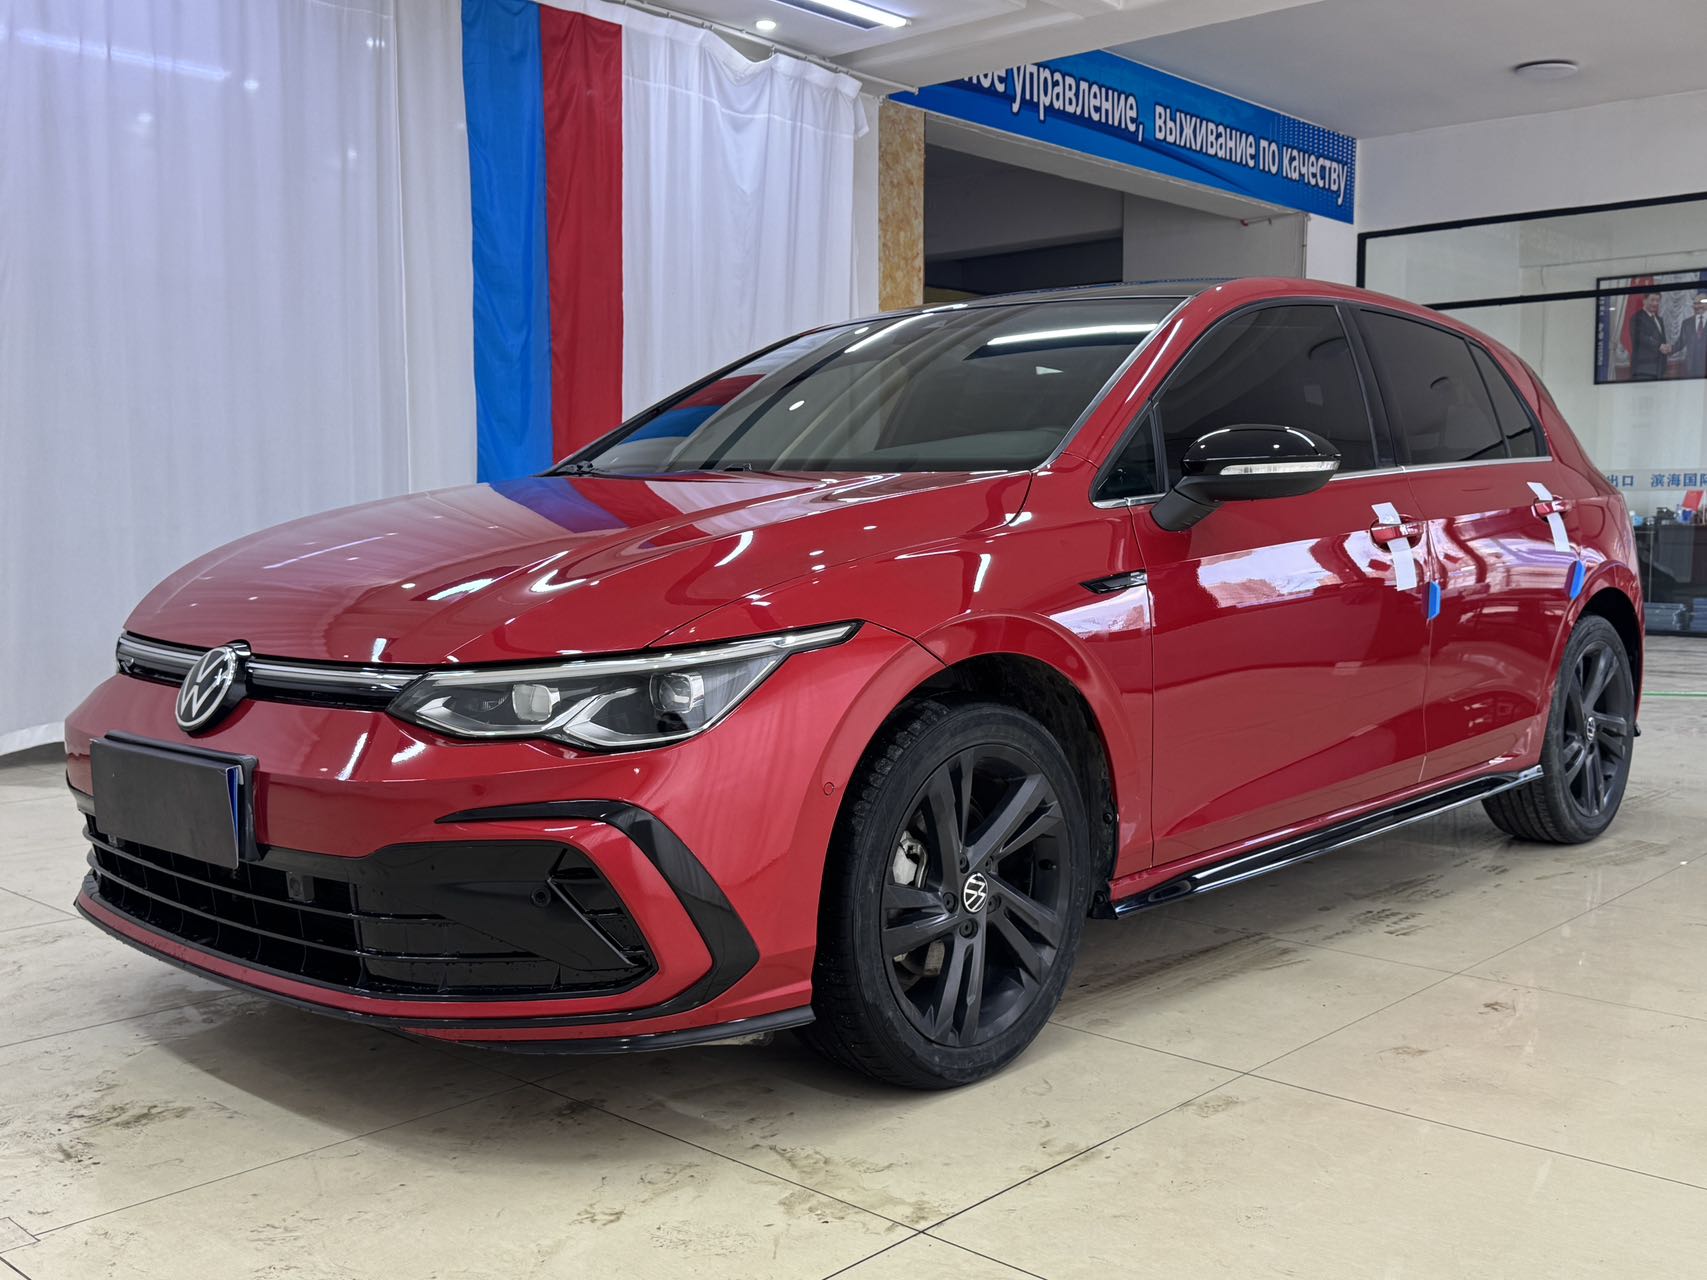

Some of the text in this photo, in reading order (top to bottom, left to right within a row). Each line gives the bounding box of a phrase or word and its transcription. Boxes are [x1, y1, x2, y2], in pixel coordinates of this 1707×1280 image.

[1012, 63, 1143, 142] управление,
[1155, 104, 1256, 168] выживание
[1259, 139, 1279, 175] по
[1283, 146, 1347, 206] качеству
